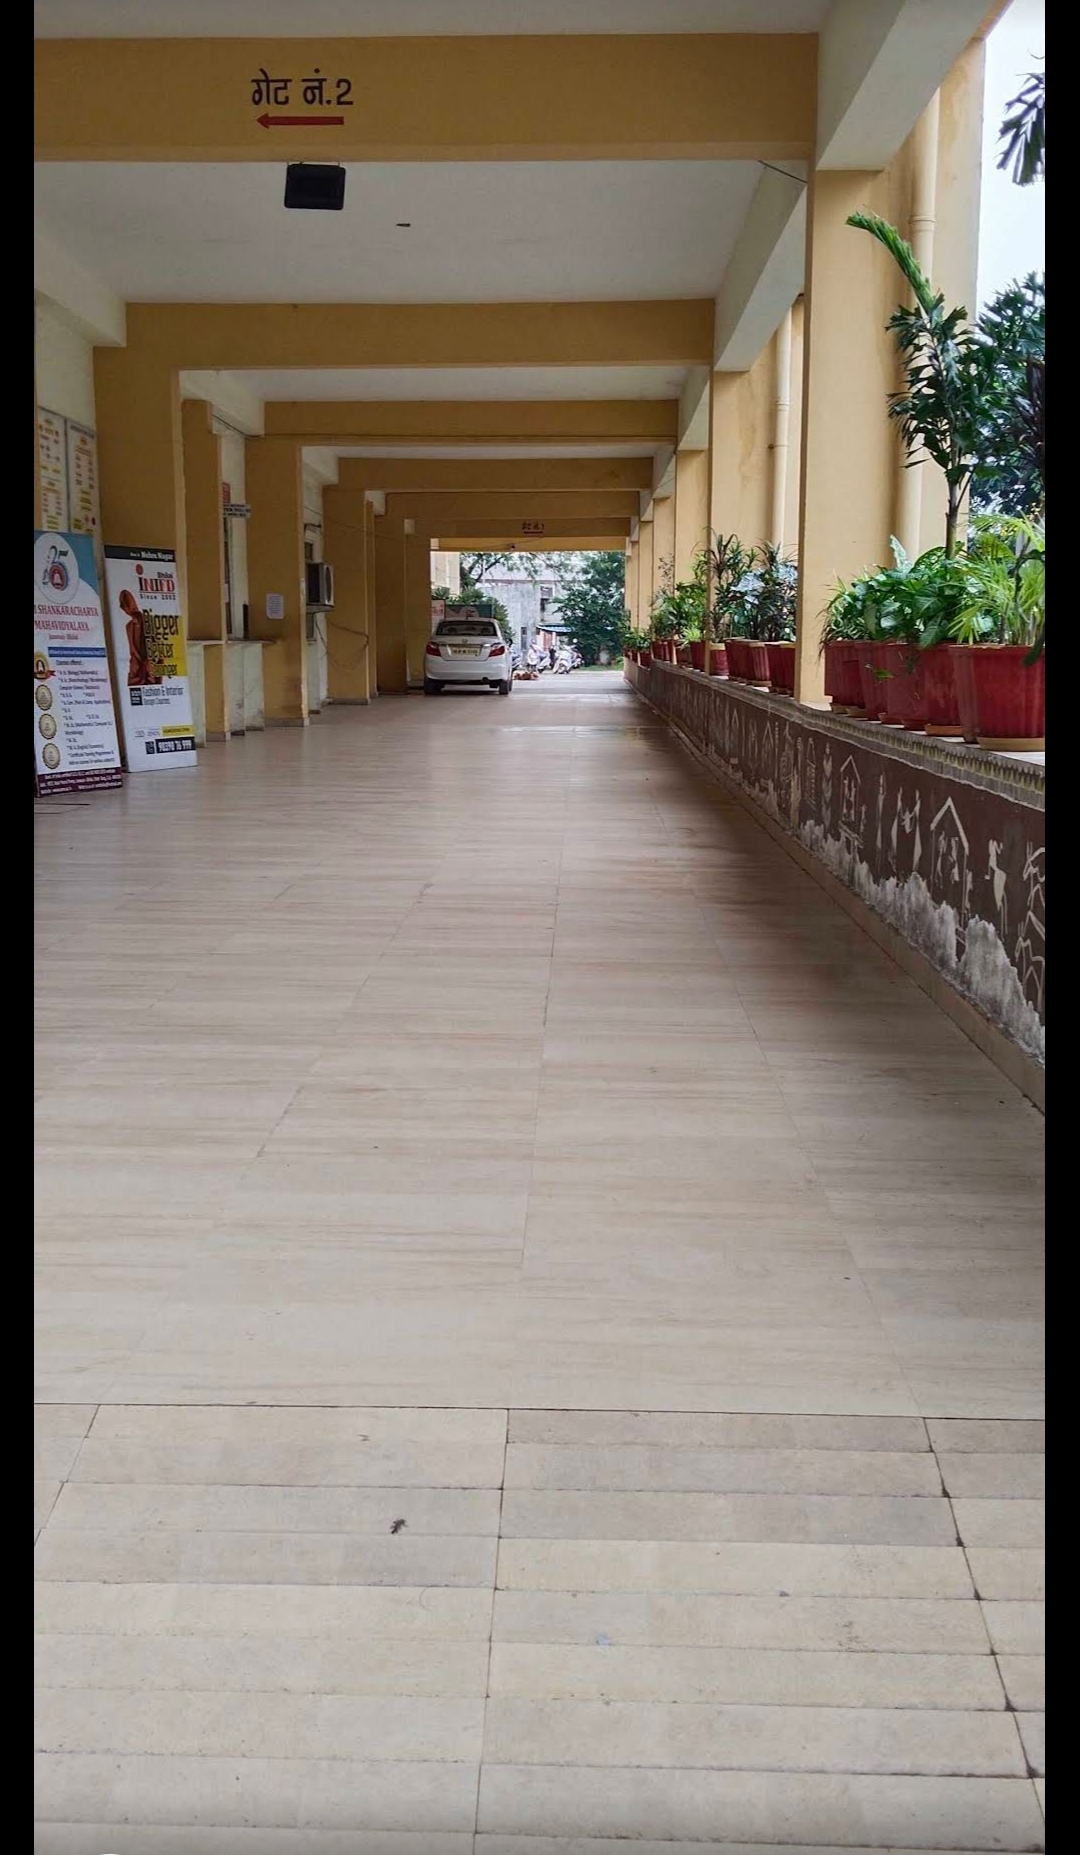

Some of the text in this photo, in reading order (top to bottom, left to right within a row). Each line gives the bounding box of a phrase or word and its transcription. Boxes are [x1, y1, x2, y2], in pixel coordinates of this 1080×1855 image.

[251, 68, 292, 105] गेट
[38, 604, 99, 617] SHANKARACHARYA
[34, 620, 90, 631] MAHAVIDYALAYA
[142, 608, 180, 641] Bigger
[146, 638, 174, 659] Better
[142, 686, 161, 696] Fashion
